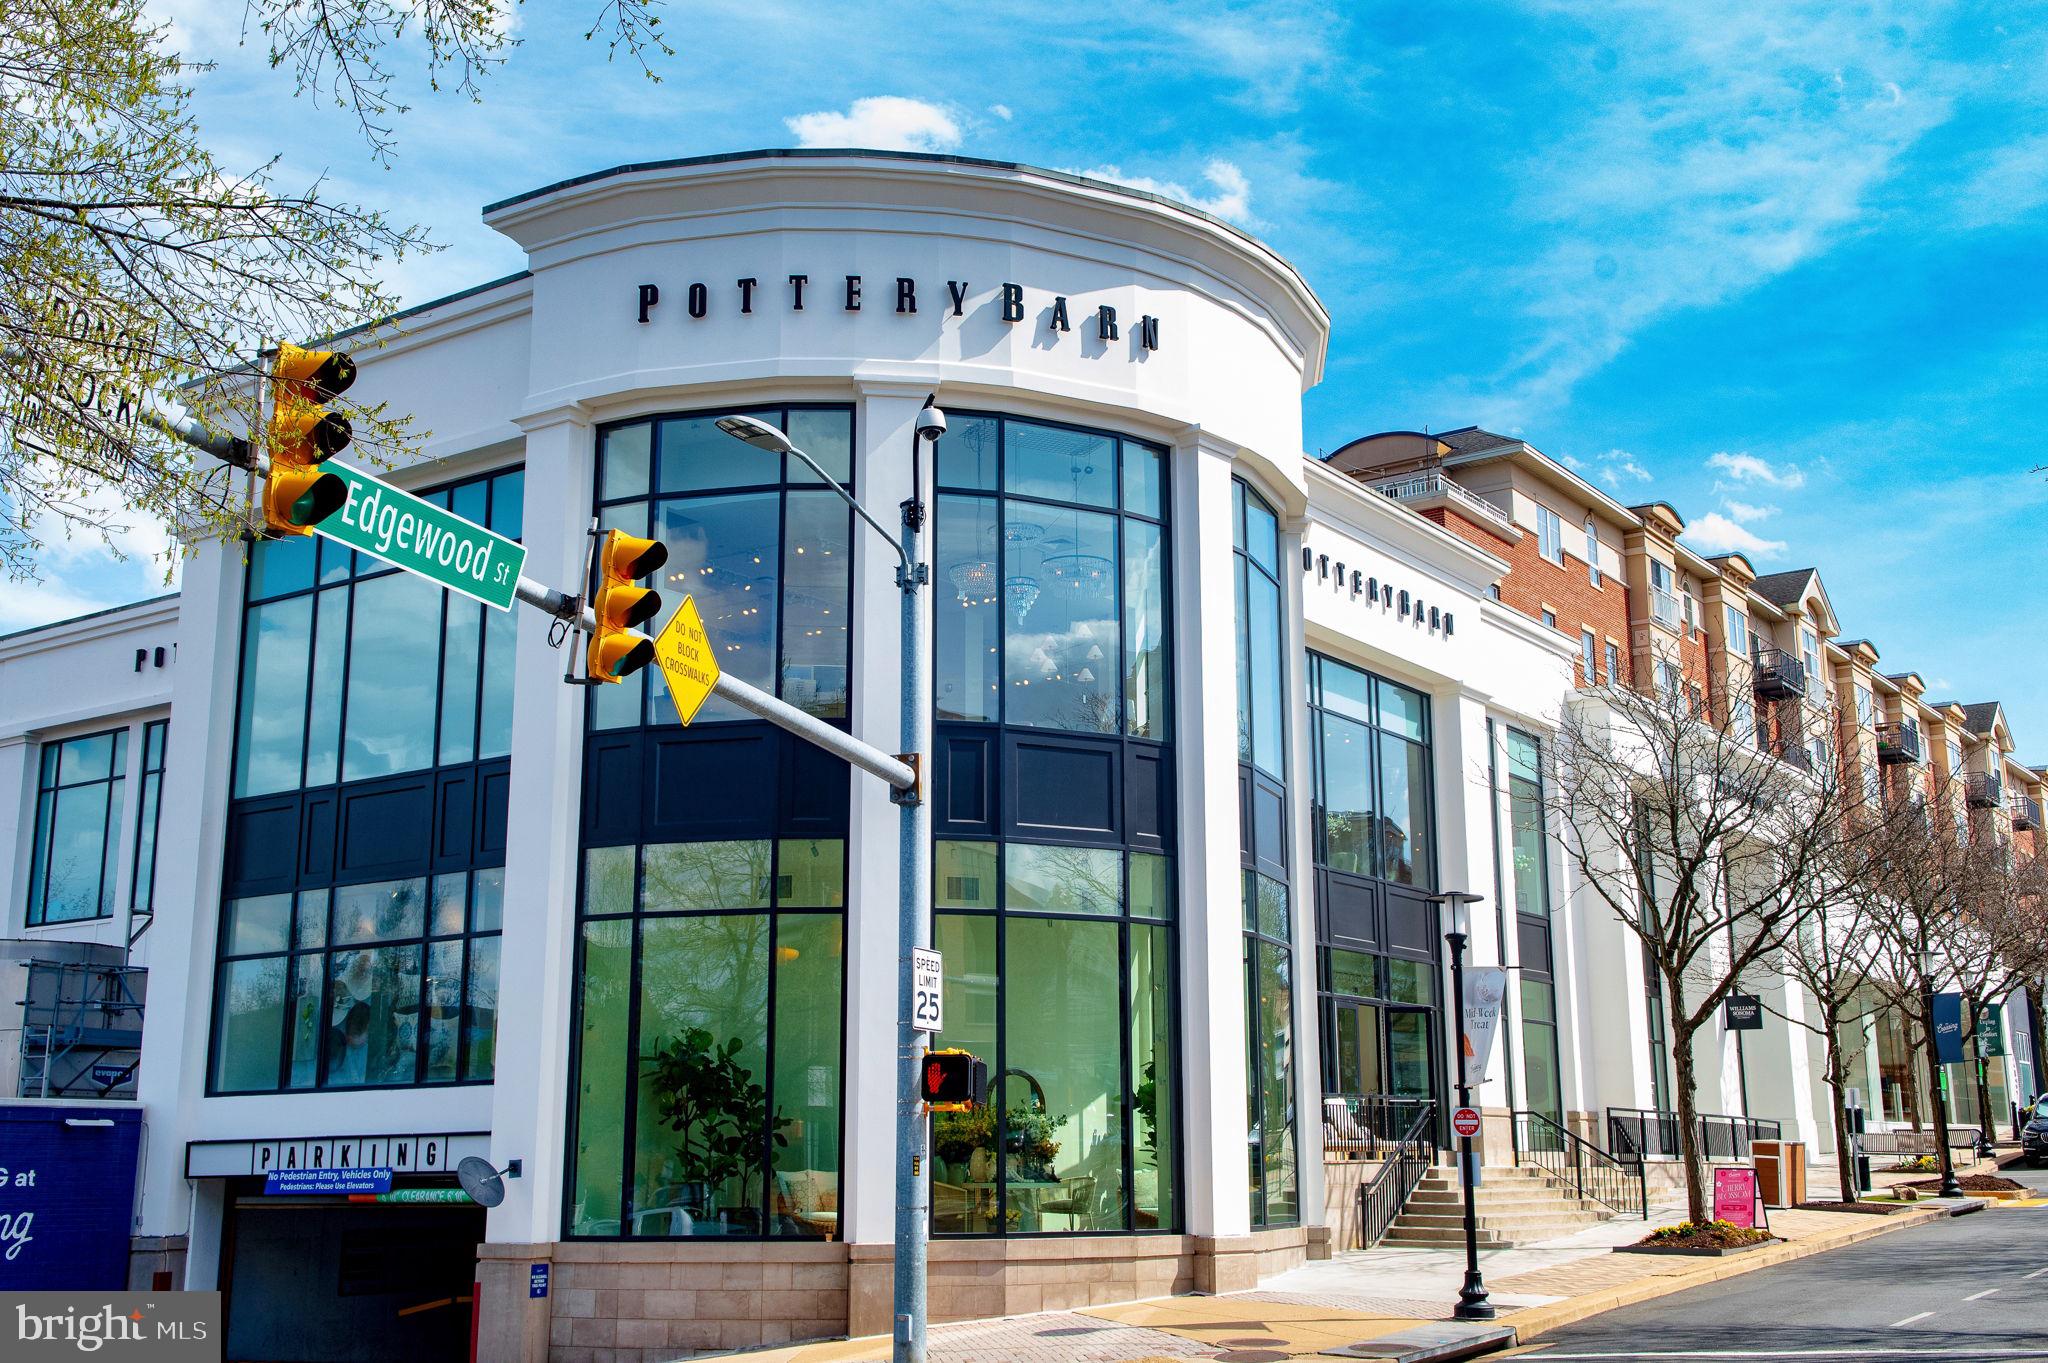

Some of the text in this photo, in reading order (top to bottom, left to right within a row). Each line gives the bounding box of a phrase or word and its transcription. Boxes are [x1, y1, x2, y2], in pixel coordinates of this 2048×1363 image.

[341, 479, 510, 586] Edgewood St
[675, 620, 702, 643] DO NOT
[135, 642, 177, 672] PO
[678, 641, 699, 662] BLOCK
[665, 656, 710, 687] CROSSWALKS
[916, 957, 940, 973] SPEED
[918, 975, 937, 989] LIMIT
[917, 990, 939, 1022] 25
[1465, 1006, 1496, 1019] Mid-Week
[1471, 1020, 1489, 1030] Treat
[262, 1142, 437, 1170] PARKING
[15, 1169, 36, 1187] at
[268, 1168, 391, 1182] No Pedestrian Entry, Vehicles Only
[279, 1180, 375, 1191] Pedestrians: Please Use Elevators
[401, 1190, 446, 1203] CLEARANCE
